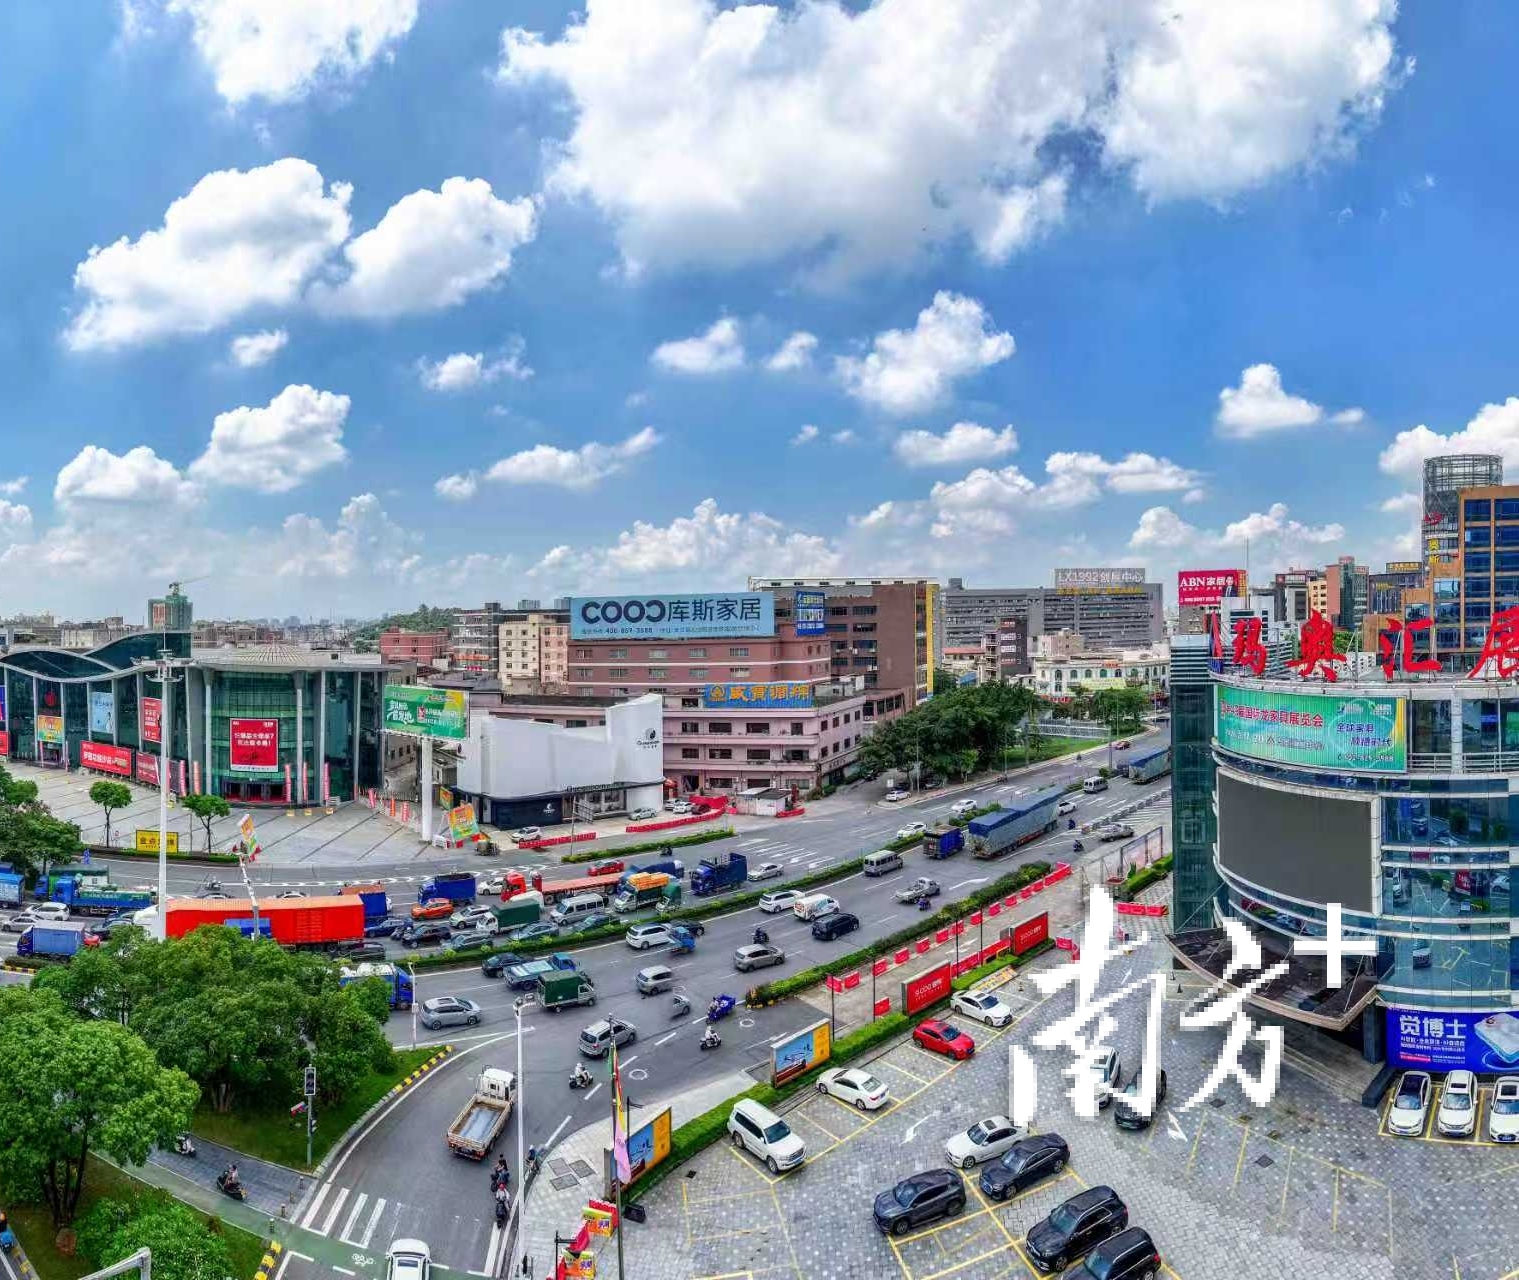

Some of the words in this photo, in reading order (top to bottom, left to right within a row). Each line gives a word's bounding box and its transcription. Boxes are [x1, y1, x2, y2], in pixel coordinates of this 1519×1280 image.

[1180, 576, 1206, 587] ABN
[667, 598, 762, 622] 库斯家居
[1399, 1014, 1468, 1039] 觉博士
